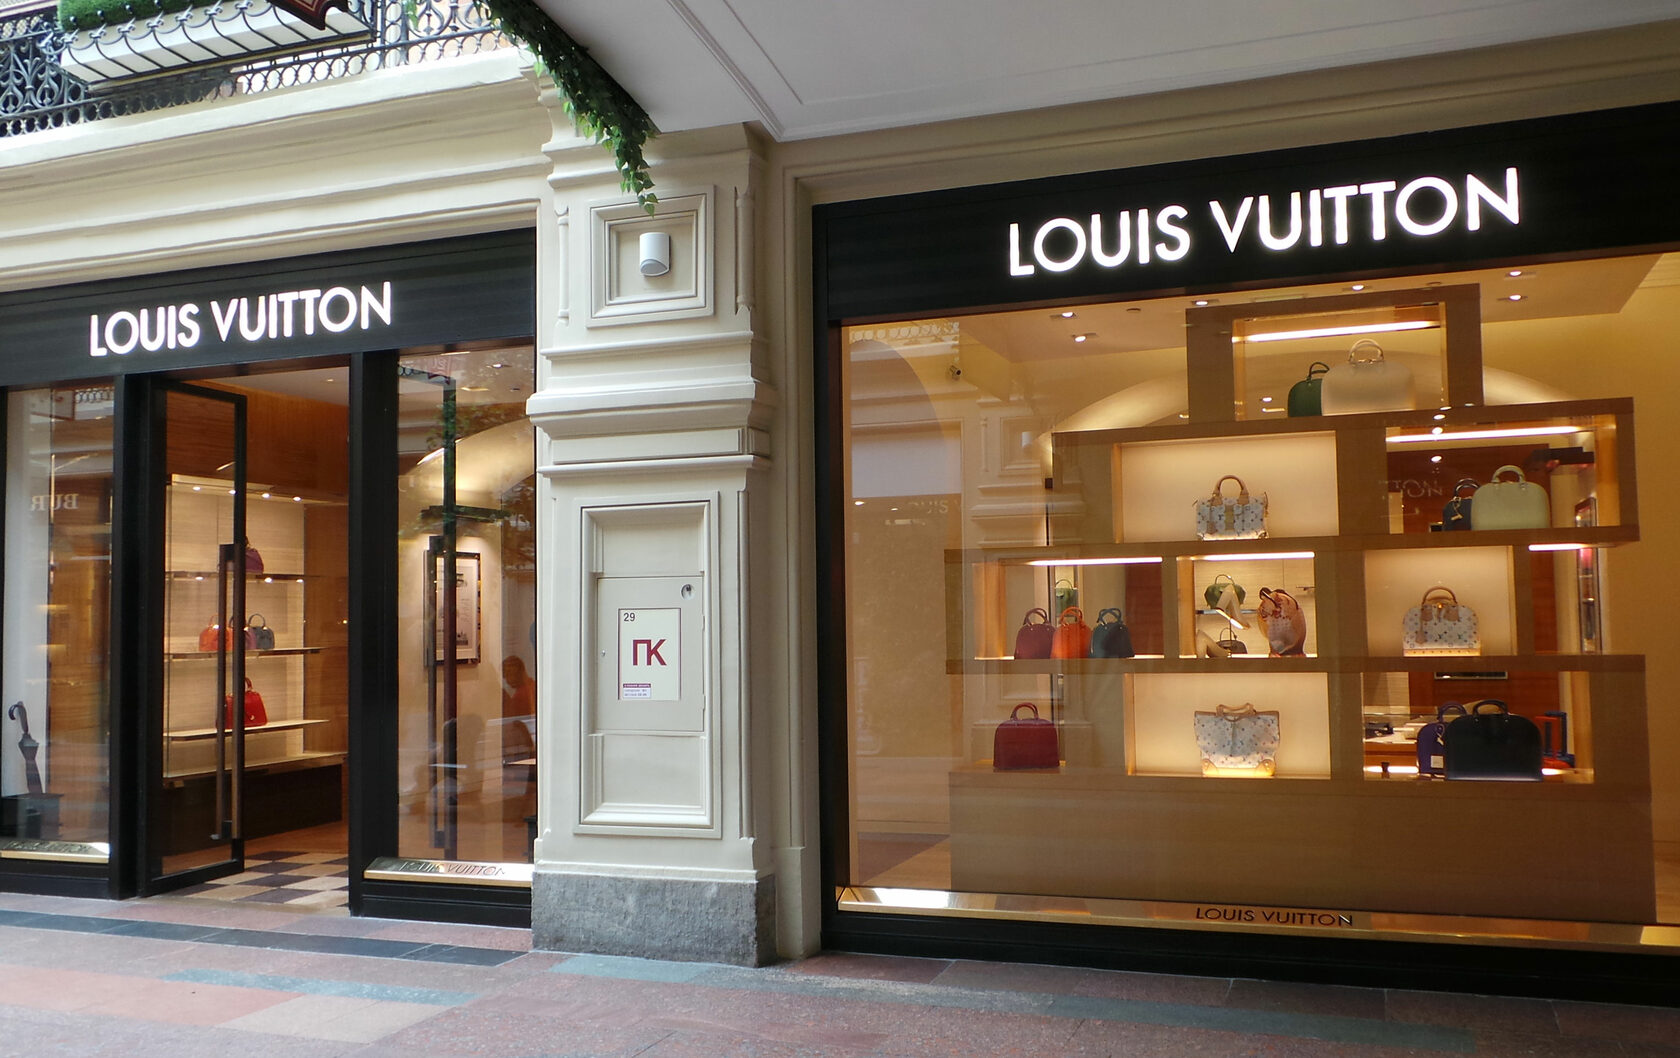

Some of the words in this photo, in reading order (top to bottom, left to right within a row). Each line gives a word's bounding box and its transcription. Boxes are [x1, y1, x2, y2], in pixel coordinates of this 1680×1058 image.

[1009, 205, 1191, 277] LOUIS
[1209, 167, 1520, 253] VUITTON
[89, 303, 201, 357] LOUIS
[210, 281, 393, 342] VUITTON
[623, 612, 636, 622] 29
[632, 639, 667, 666] ПК
[1195, 907, 1256, 921] LOUIS
[1261, 910, 1353, 926] VUITTON
